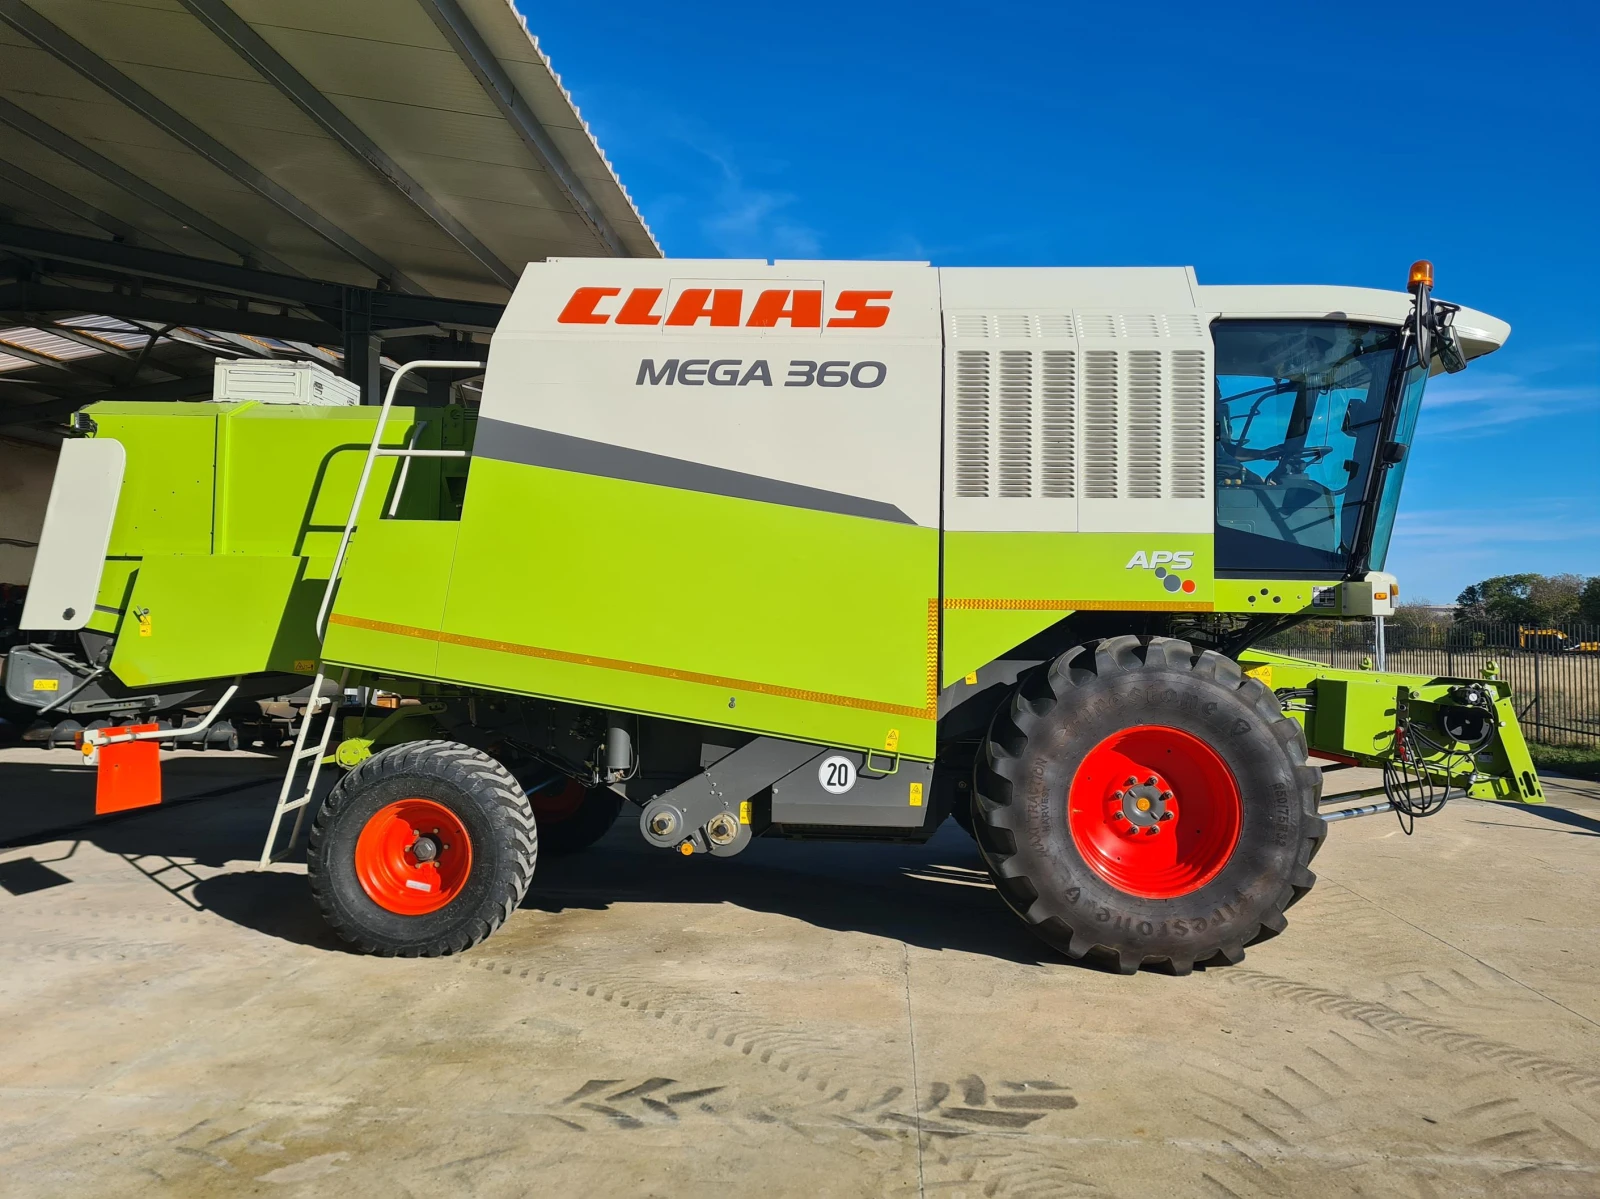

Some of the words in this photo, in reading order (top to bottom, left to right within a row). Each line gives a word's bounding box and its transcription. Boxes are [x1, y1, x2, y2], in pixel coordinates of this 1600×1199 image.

[557, 286, 894, 328] CLAAS
[635, 358, 773, 387] MEGA
[784, 360, 888, 389] 360
[1125, 550, 1195, 570] APS
[826, 762, 849, 788] 20
[1094, 890, 1255, 940] Firestone
